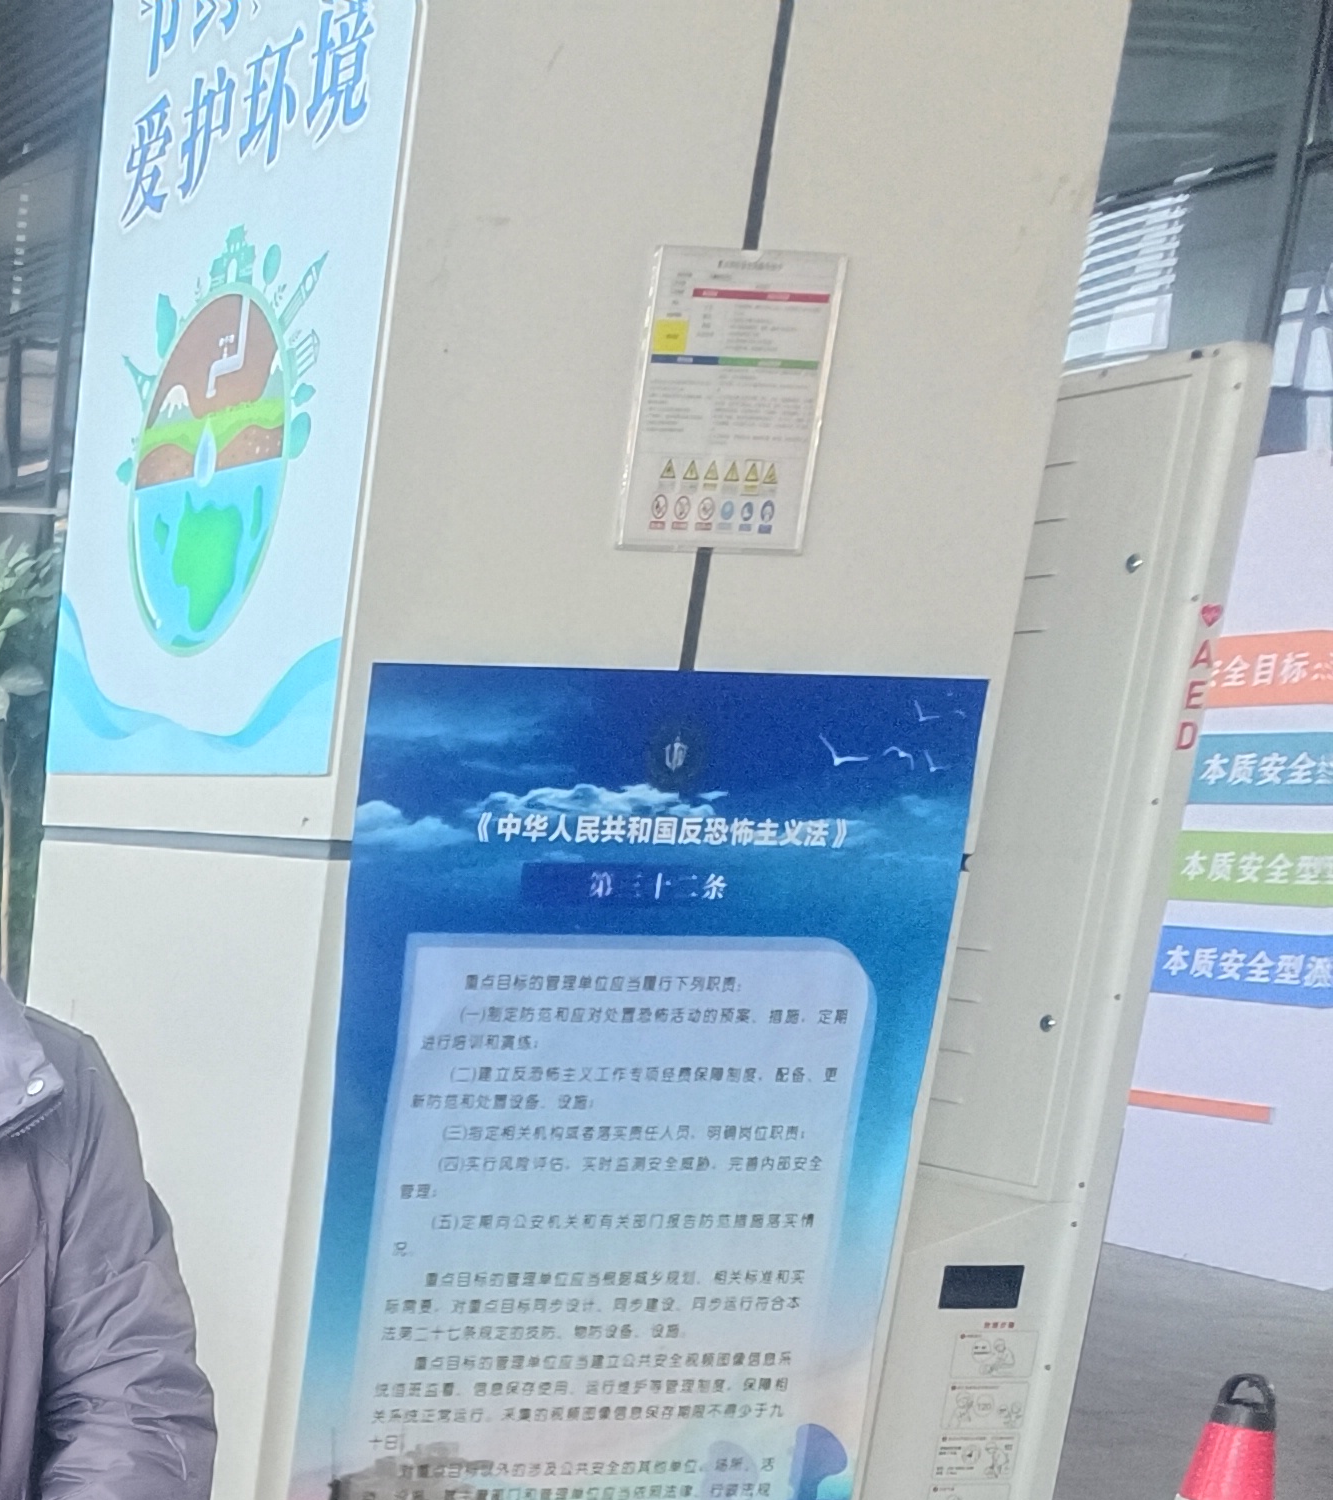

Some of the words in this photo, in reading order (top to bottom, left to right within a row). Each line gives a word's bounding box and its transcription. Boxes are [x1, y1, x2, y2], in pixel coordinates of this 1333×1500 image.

[121, 0, 374, 229] 爱护环境
[1176, 639, 1213, 750] AED
[477, 813, 847, 849] 《中华人民共和国反恐怖主义法》
